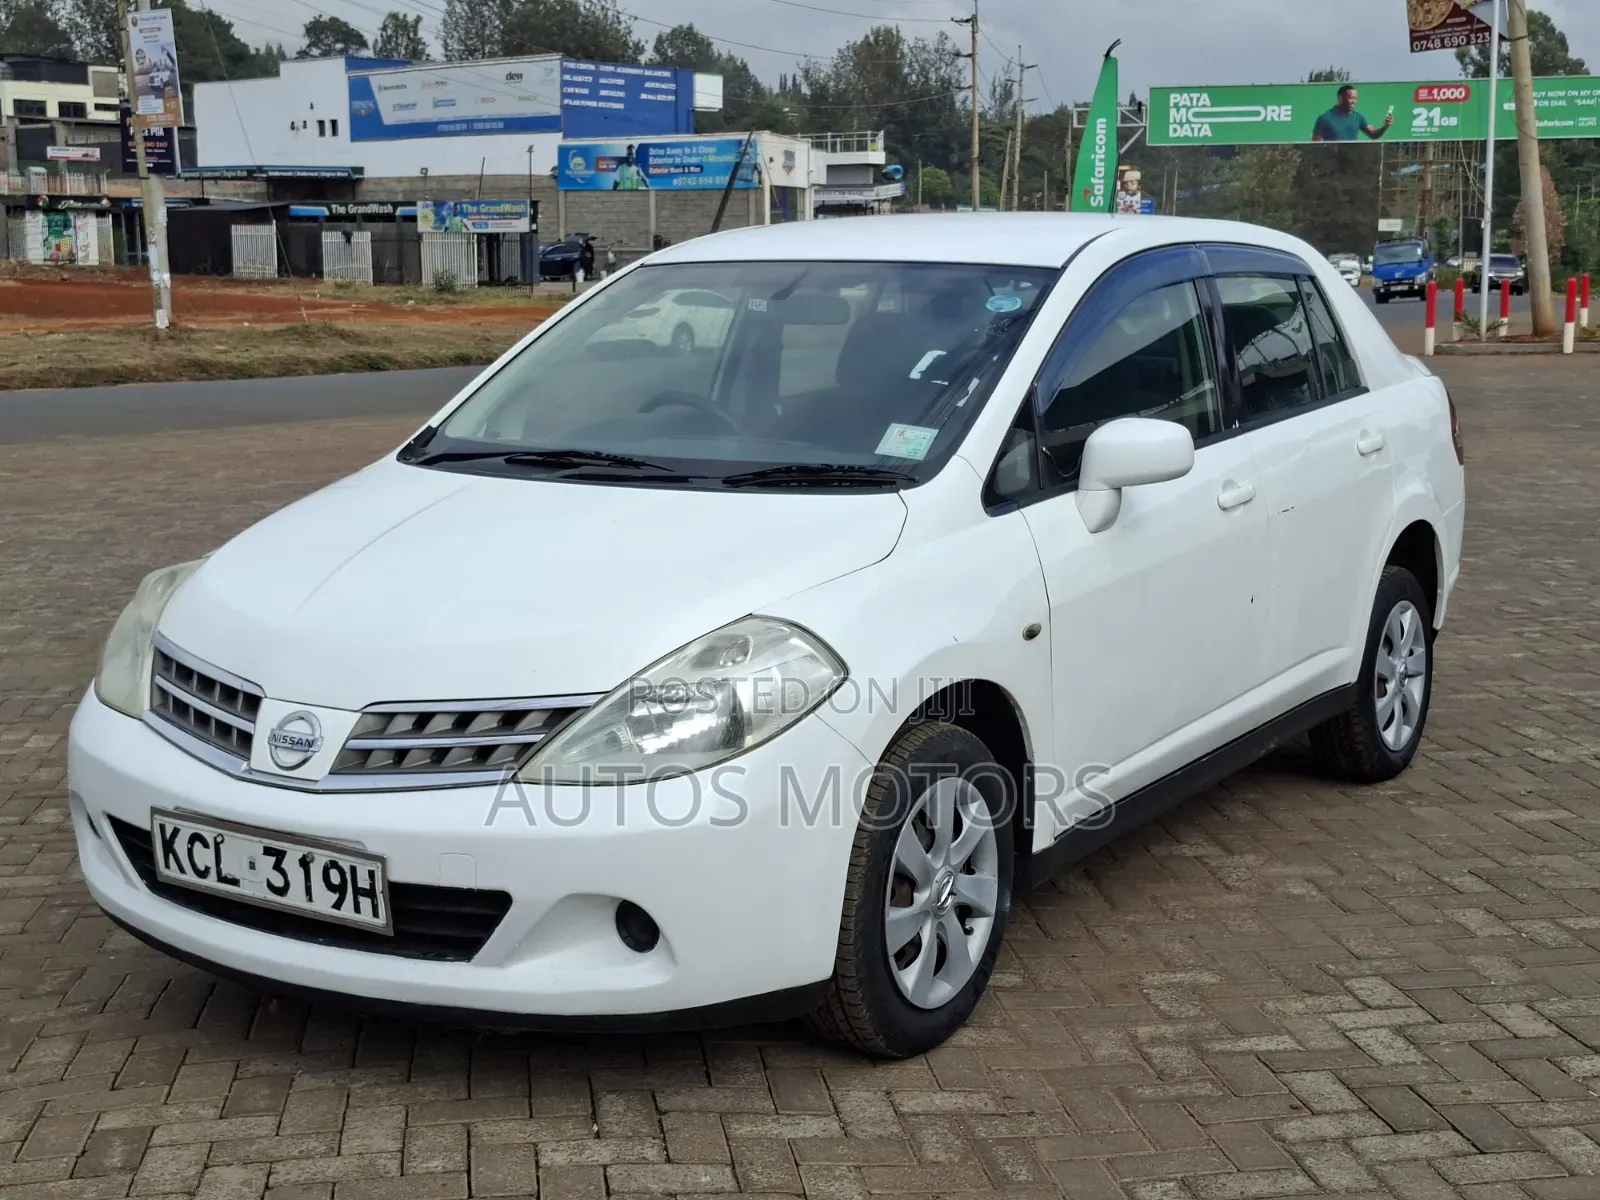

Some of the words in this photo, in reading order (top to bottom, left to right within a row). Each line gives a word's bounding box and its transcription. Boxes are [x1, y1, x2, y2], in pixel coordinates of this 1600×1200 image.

[1413, 38, 1441, 52] 0748
[1444, 35, 1467, 47] 690
[1469, 32, 1491, 44] 323
[1169, 92, 1211, 107] PATA
[1432, 88, 1465, 101] 1,000
[1550, 99, 1567, 107] DIAL
[1168, 123, 1212, 138] DATA
[1090, 118, 1107, 207] Safaricom
[331, 204, 346, 214] The
[347, 203, 394, 215] GrandWash
[462, 204, 478, 213] The
[479, 203, 527, 213] GrandWash
[271, 732, 315, 749] NISSAN
[158, 822, 241, 888] KCL
[262, 845, 380, 919] 319H
